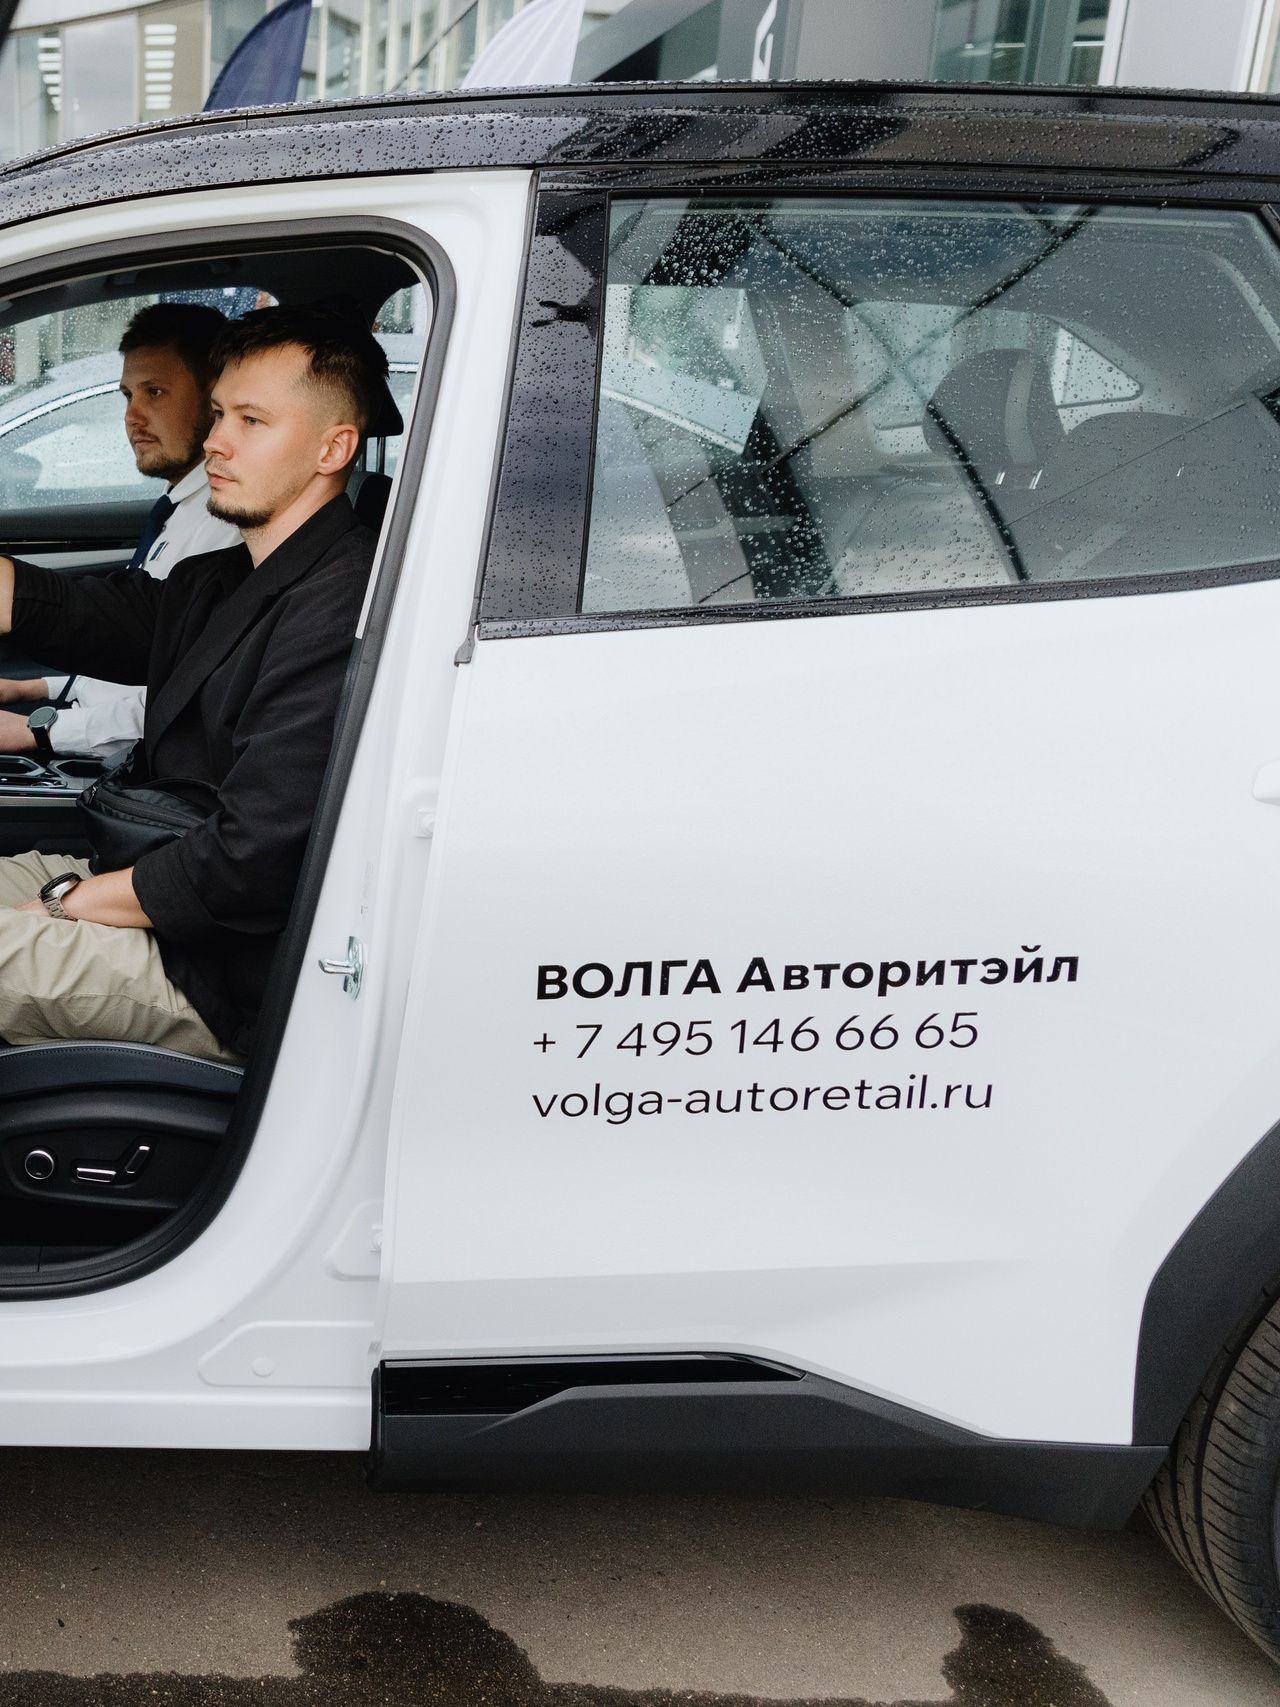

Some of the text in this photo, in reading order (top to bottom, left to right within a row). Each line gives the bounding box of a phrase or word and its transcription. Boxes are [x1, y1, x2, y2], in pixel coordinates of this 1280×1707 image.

[536, 944, 1079, 1000] ВОЛГА Авторитэйл
[533, 1012, 978, 1059] + 7 495 146 66 65
[532, 1074, 993, 1125] volga-autoretail.ru
